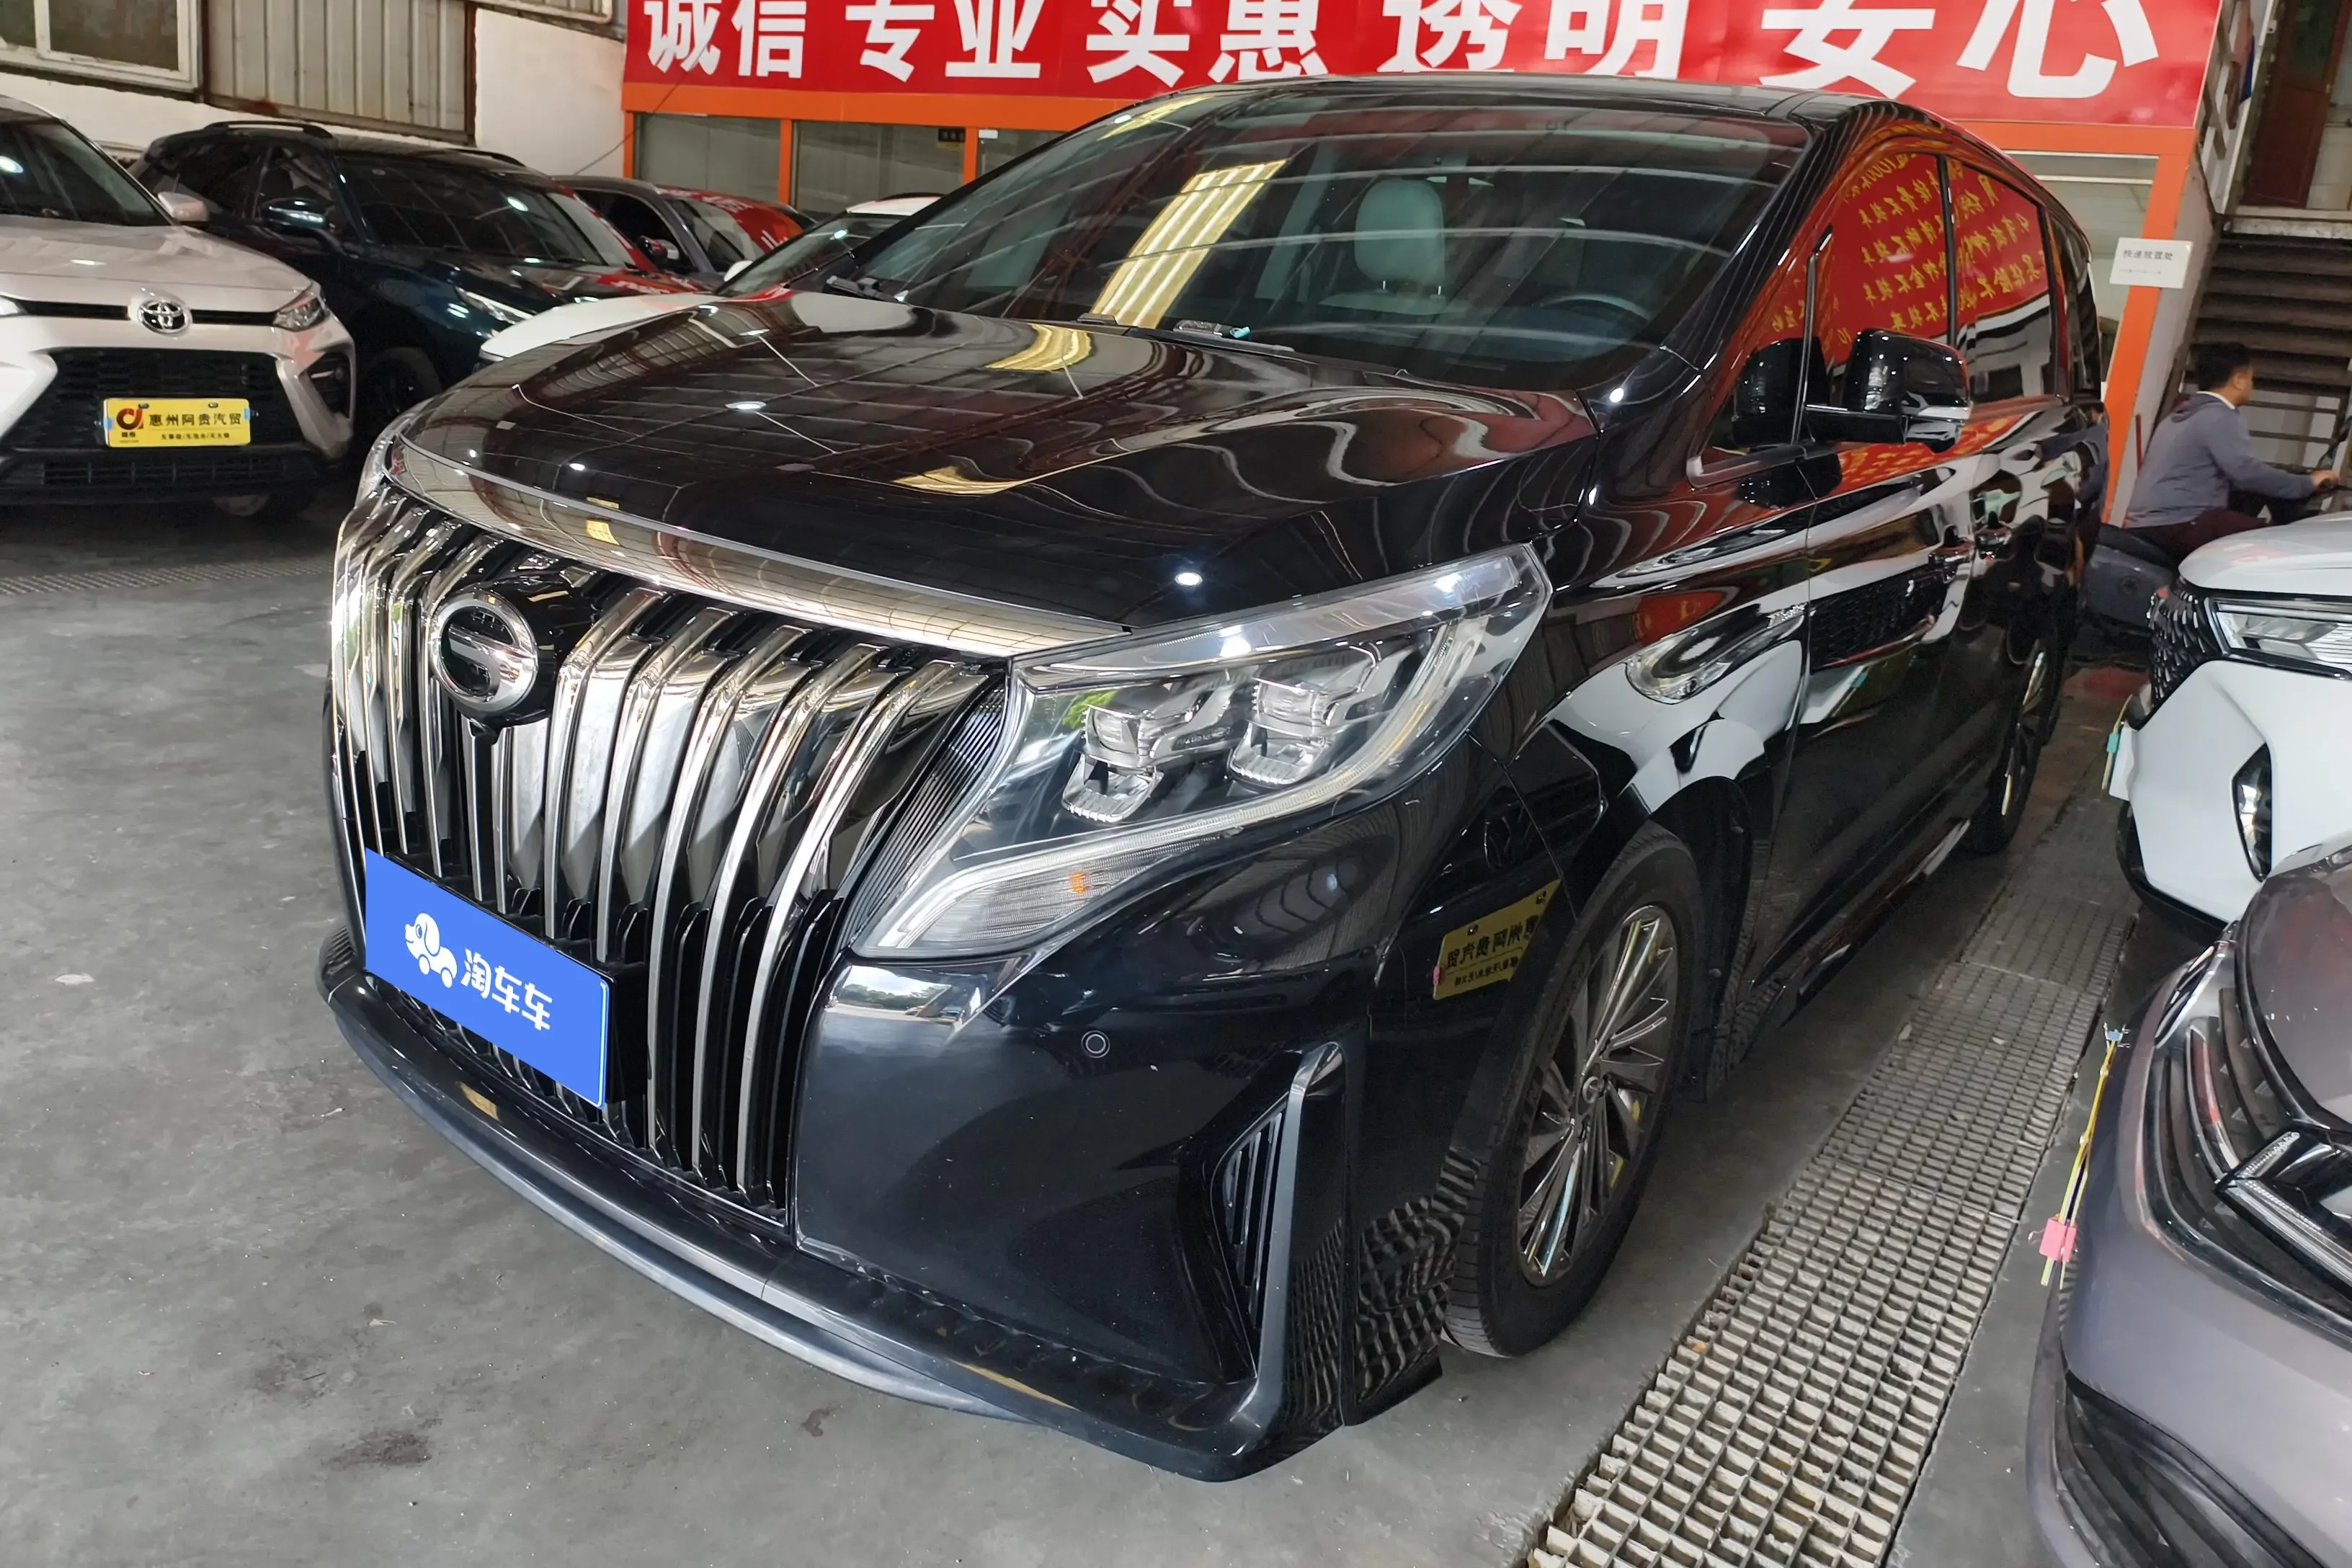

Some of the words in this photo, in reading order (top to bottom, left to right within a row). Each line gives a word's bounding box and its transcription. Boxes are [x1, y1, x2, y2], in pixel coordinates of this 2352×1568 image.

[643, 0, 807, 79] 诚信
[845, 0, 1046, 83] 专业
[148, 412, 242, 427] 惠州阿贵汽贸
